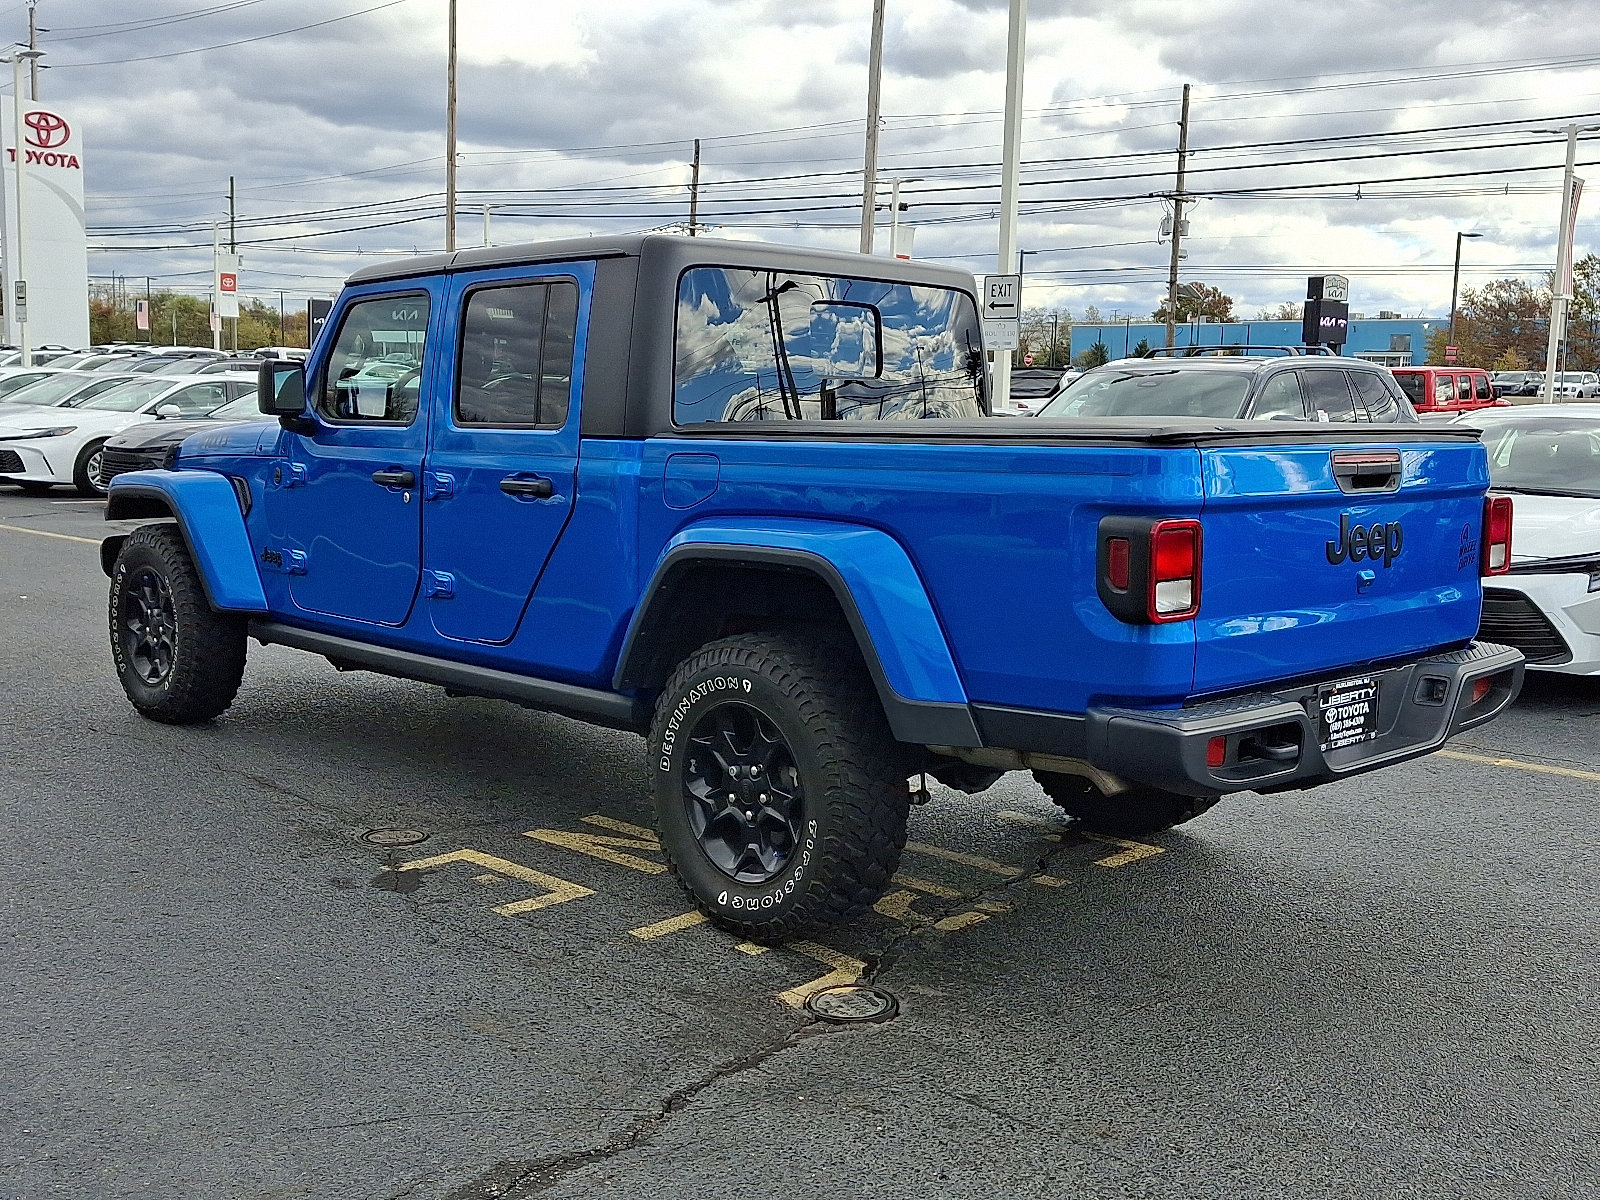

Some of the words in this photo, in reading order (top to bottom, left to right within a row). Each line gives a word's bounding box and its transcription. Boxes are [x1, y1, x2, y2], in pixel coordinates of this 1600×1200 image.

[7, 148, 80, 169] TOYOTA
[990, 283, 1013, 298] EXIT
[1325, 511, 1404, 569] Jeep
[260, 545, 283, 568] Jeep
[1319, 686, 1377, 708] LIBERTY
[1338, 702, 1369, 719] TOYOTA
[659, 677, 740, 772] DESTINATION
[1332, 734, 1365, 748] LIBERTY
[731, 819, 817, 911] Firestone
